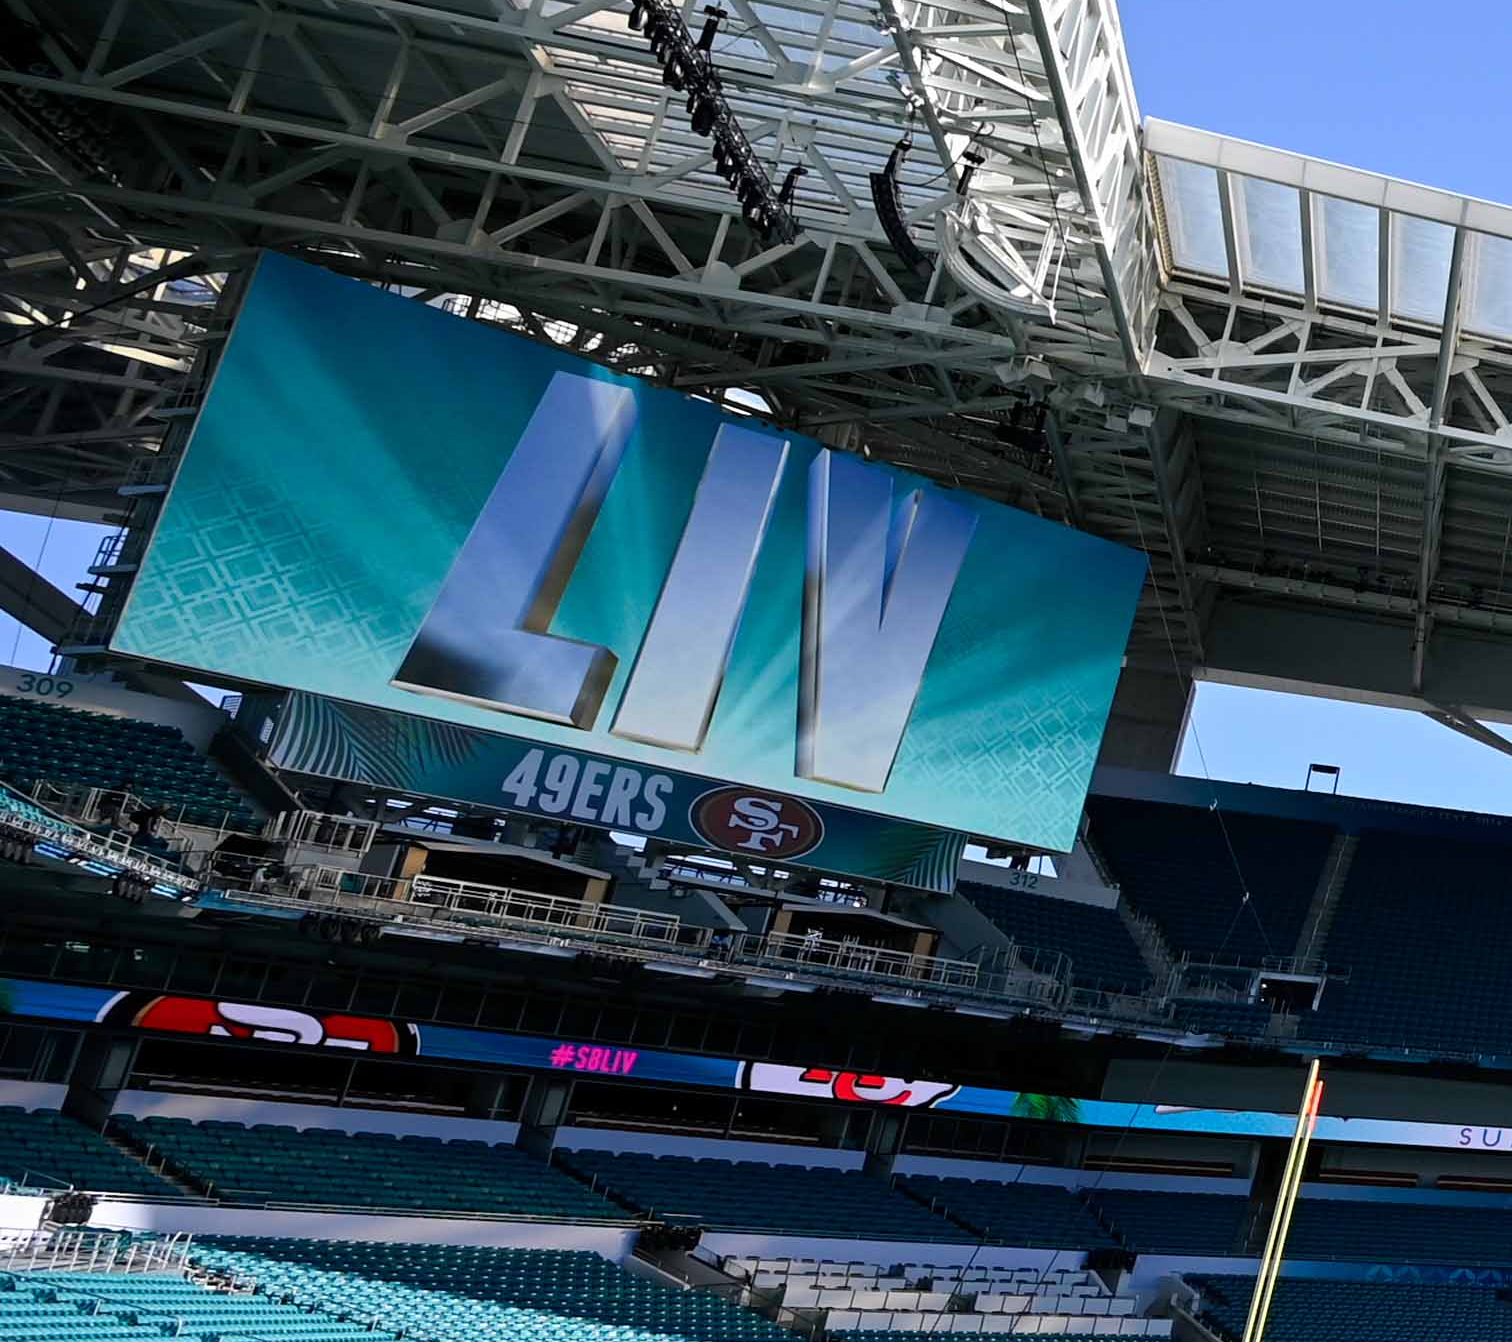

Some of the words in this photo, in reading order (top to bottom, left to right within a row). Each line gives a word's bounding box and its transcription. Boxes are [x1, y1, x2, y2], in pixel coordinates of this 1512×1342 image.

[389, 370, 979, 795] LIV
[16, 673, 74, 700] 309
[502, 749, 674, 832] 49ERS
[1008, 874, 1038, 890] 312
[549, 1044, 640, 1074] #SBLIV
